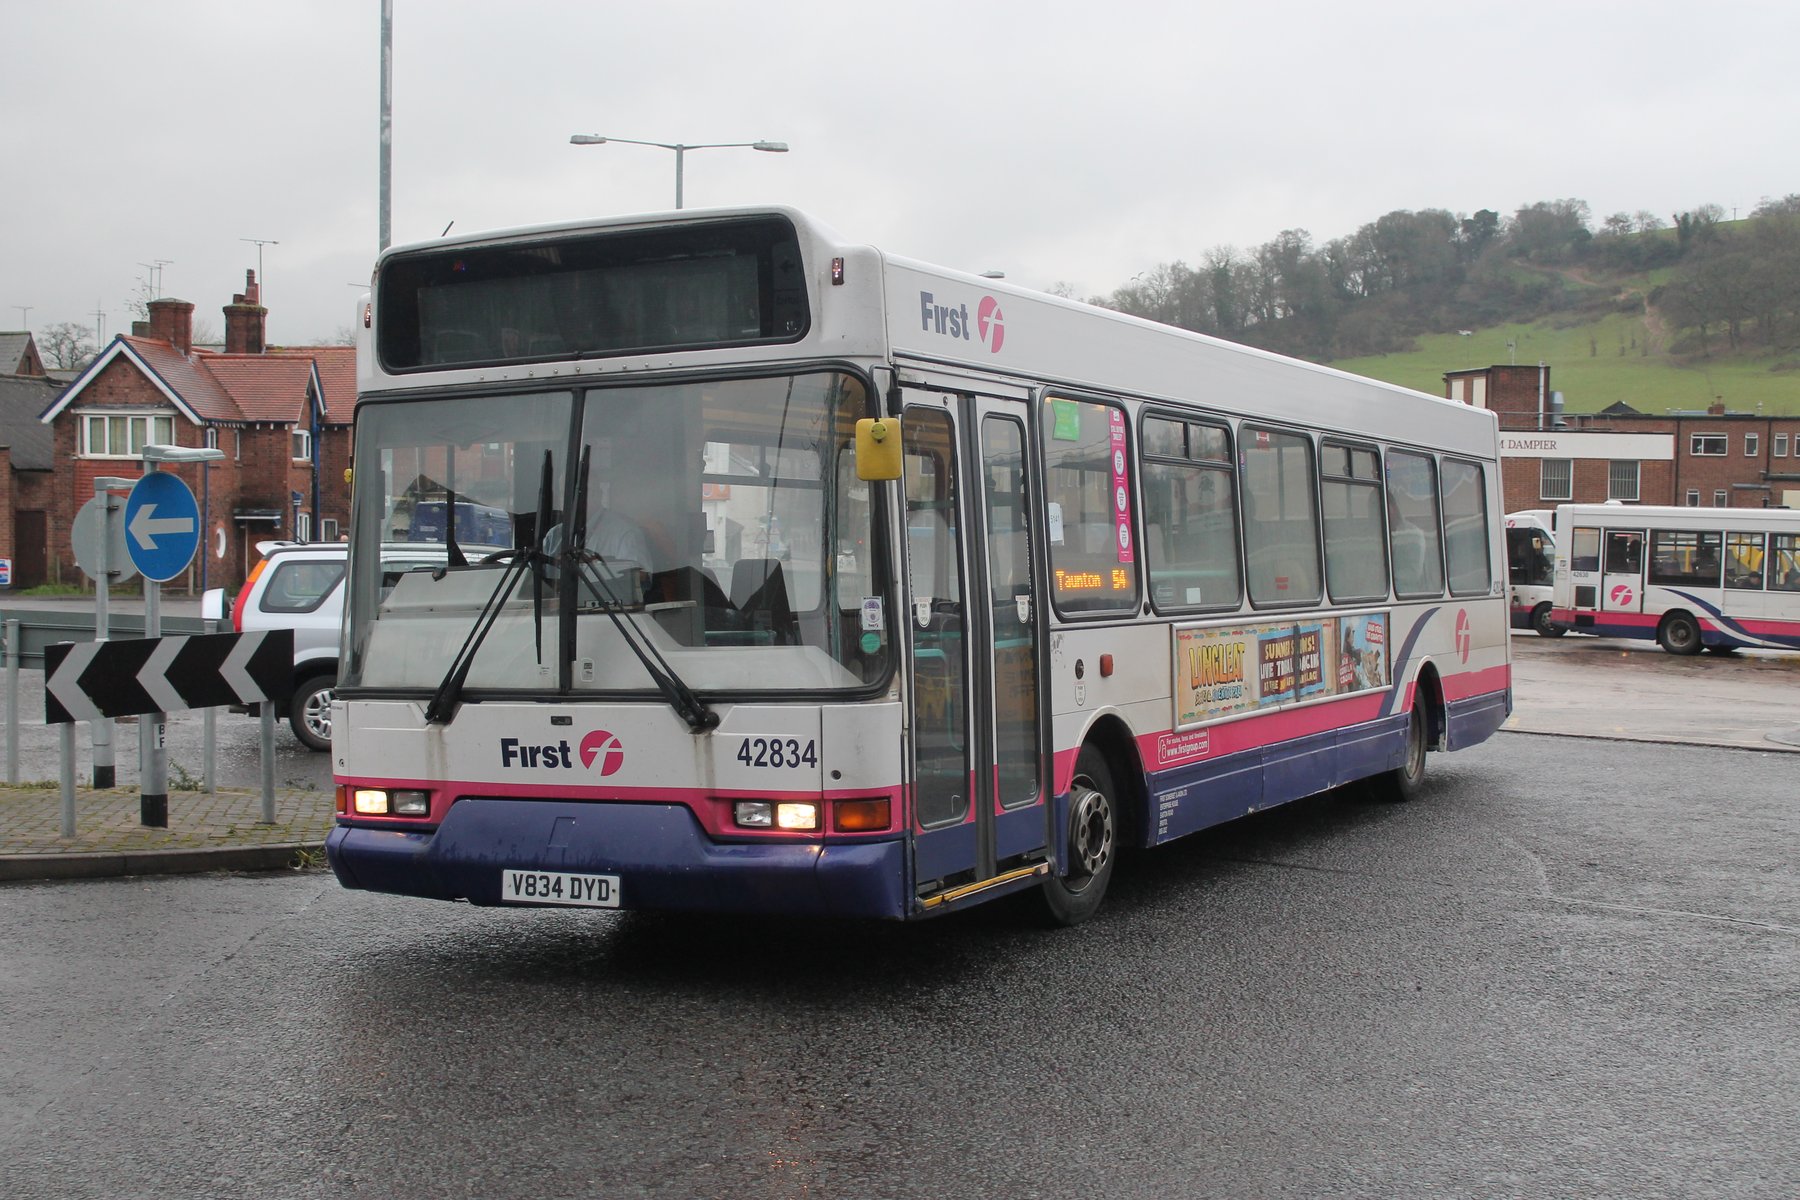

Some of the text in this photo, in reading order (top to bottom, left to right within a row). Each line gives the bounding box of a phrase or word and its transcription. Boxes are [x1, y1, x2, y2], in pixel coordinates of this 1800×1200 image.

[920, 290, 970, 341] First
[1508, 439, 1557, 450] DAMPIER
[1056, 569, 1127, 591] Taunton 54
[501, 738, 572, 768] First
[737, 738, 818, 768] 42834
[512, 873, 610, 902] V834 DYD
